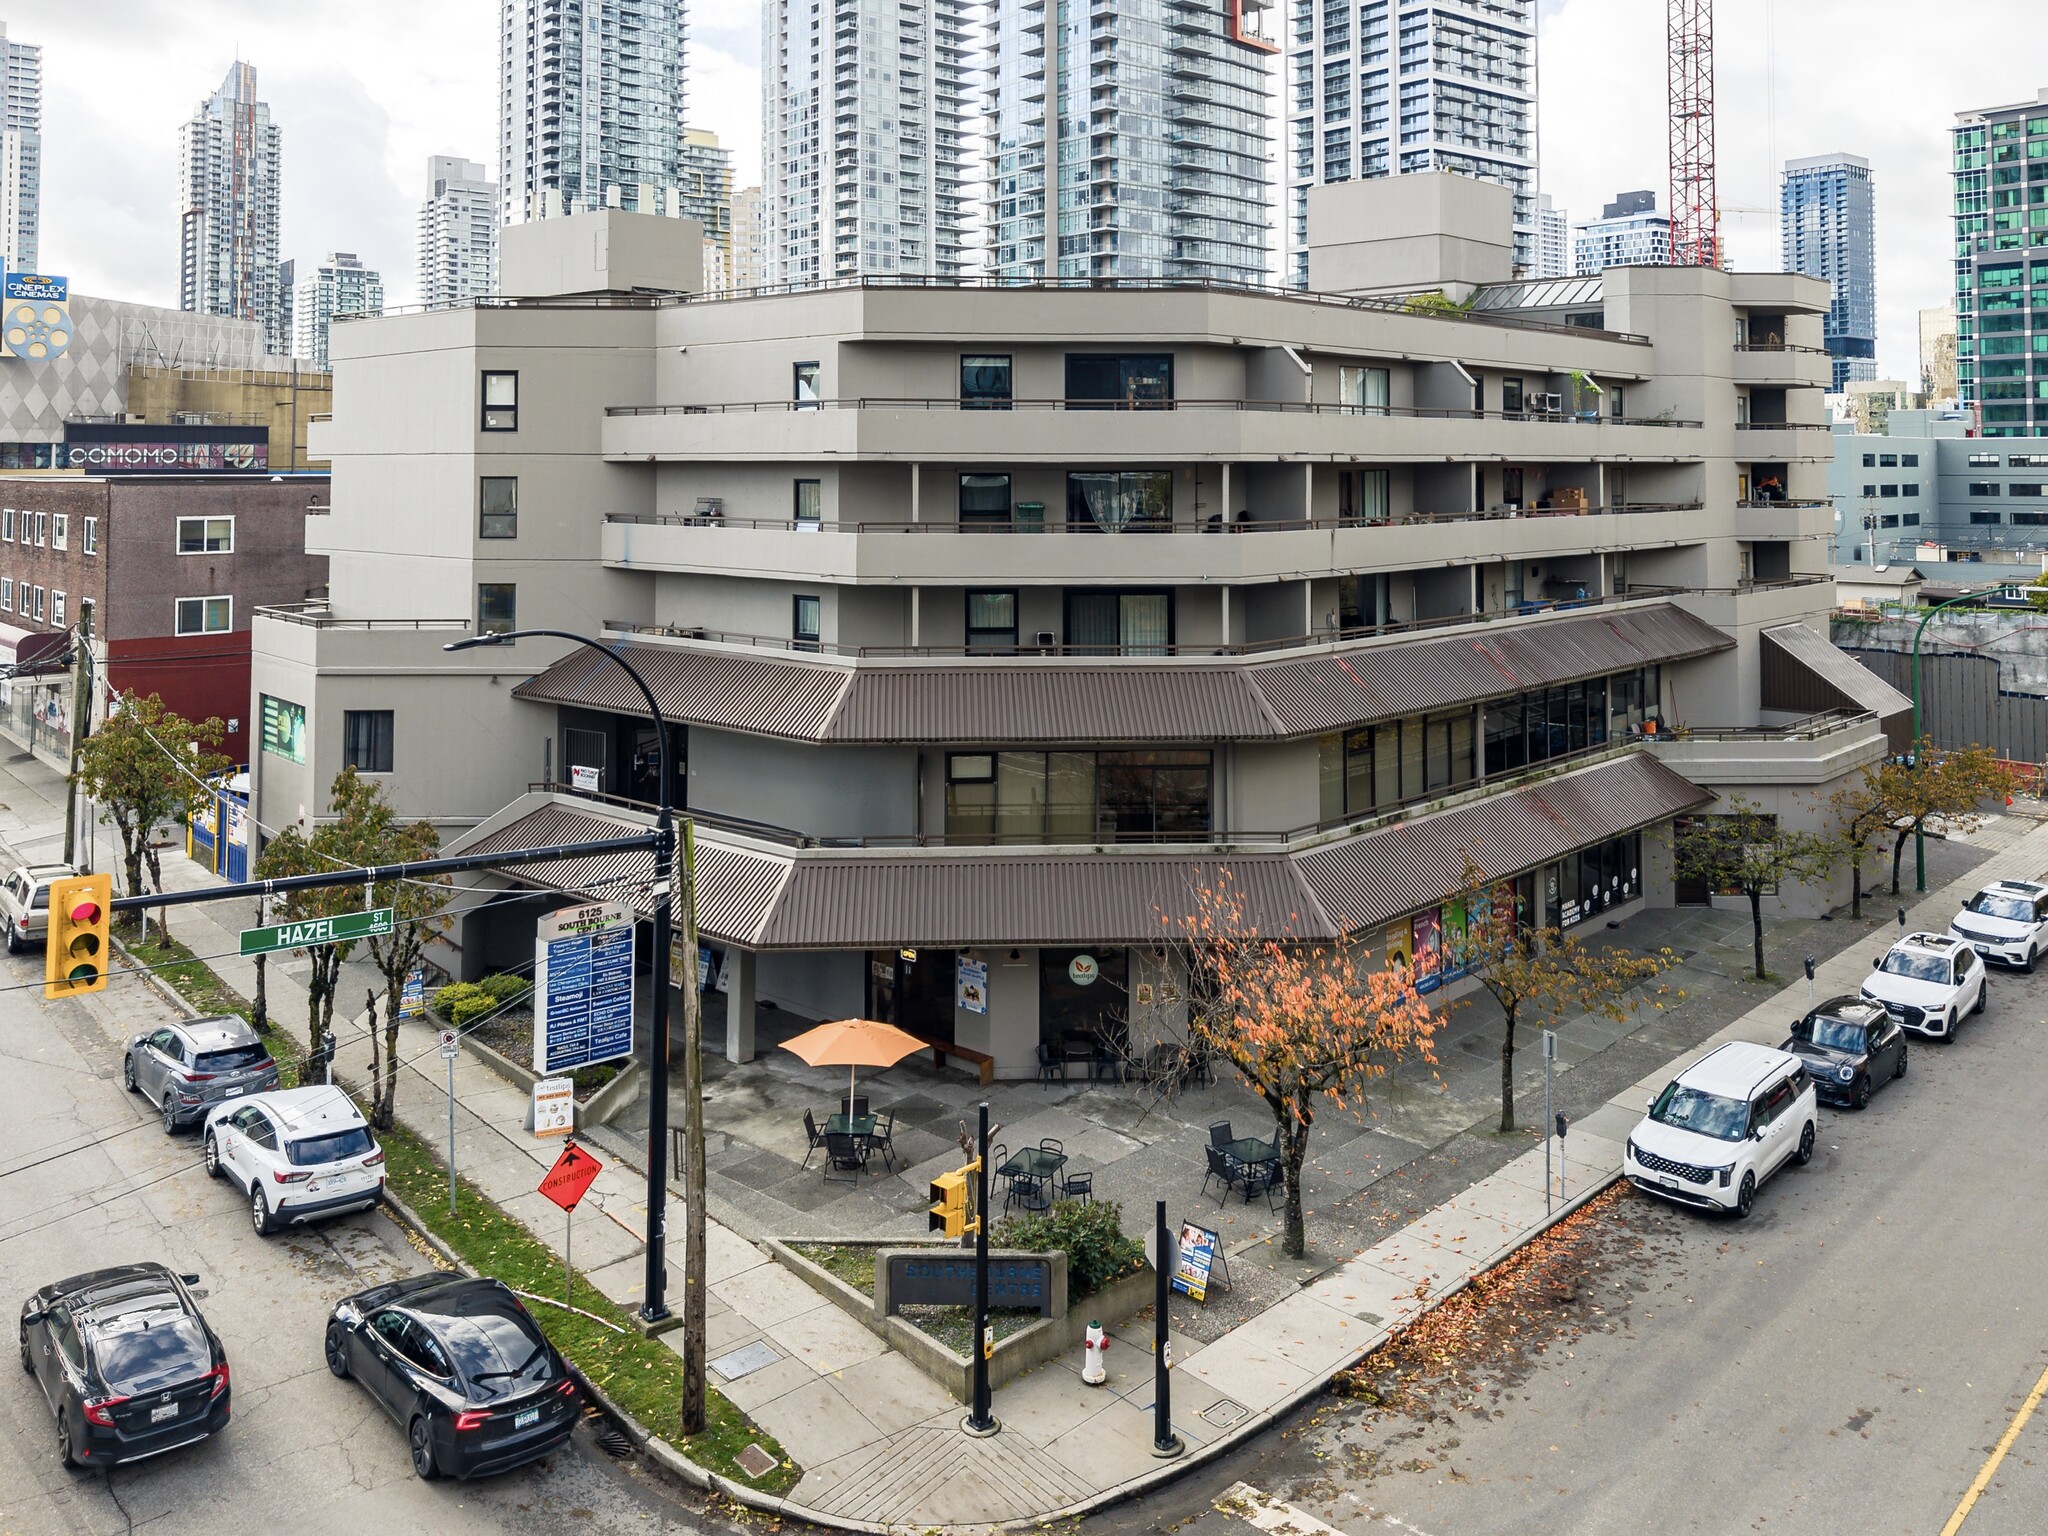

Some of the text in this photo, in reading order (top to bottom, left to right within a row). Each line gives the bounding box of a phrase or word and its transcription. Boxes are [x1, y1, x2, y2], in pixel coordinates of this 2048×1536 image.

[8, 283, 65, 293] CINEPLEX
[14, 291, 60, 299] CINEMAS
[1562, 899, 1576, 912] MAKER
[373, 912, 384, 922] ST
[578, 907, 602, 919] 6125
[1562, 905, 1581, 920] ACADEMY
[558, 913, 622, 931] SOUTH BOURNE
[1414, 920, 1428, 930] French
[1562, 917, 1570, 928] FOR
[277, 920, 338, 945] HAZEL
[577, 924, 605, 934] CENRE
[902, 950, 915, 959] OPEN
[555, 991, 583, 1003] Steamoji
[613, 995, 630, 1003] College
[542, 1165, 597, 1191] CONSTRUCTION
